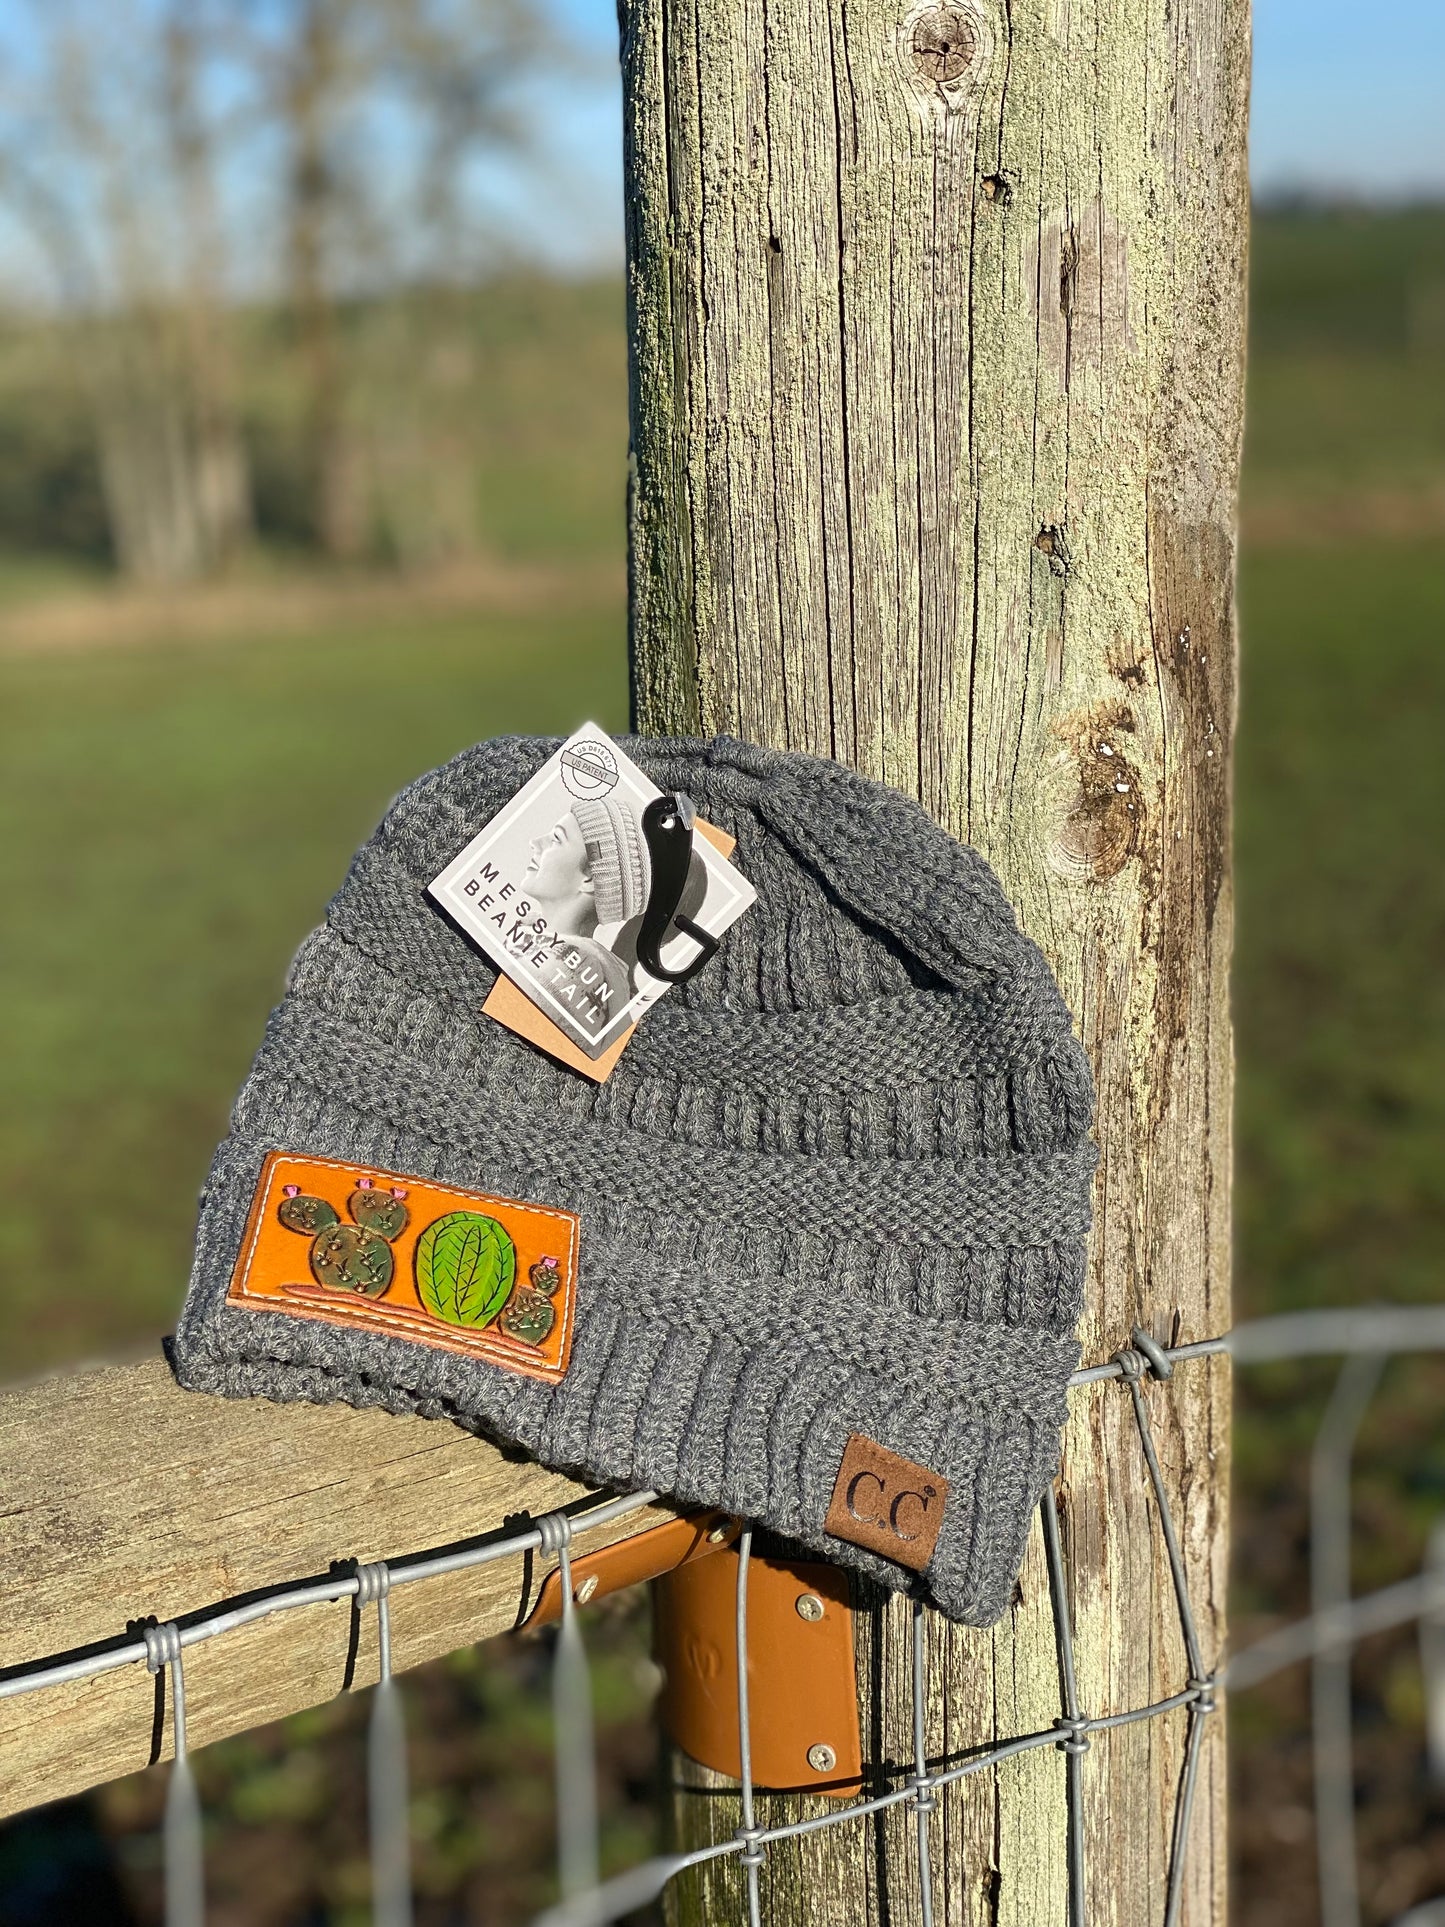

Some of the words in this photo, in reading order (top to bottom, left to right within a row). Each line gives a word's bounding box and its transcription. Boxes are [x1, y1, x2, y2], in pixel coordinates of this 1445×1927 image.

[571, 758, 581, 768] US
[582, 762, 609, 780] PATENT
[463, 878, 549, 969] BEANIE
[550, 967, 601, 1025] TAIL
[479, 862, 565, 949] MESSY
[563, 950, 615, 1003] BUN
